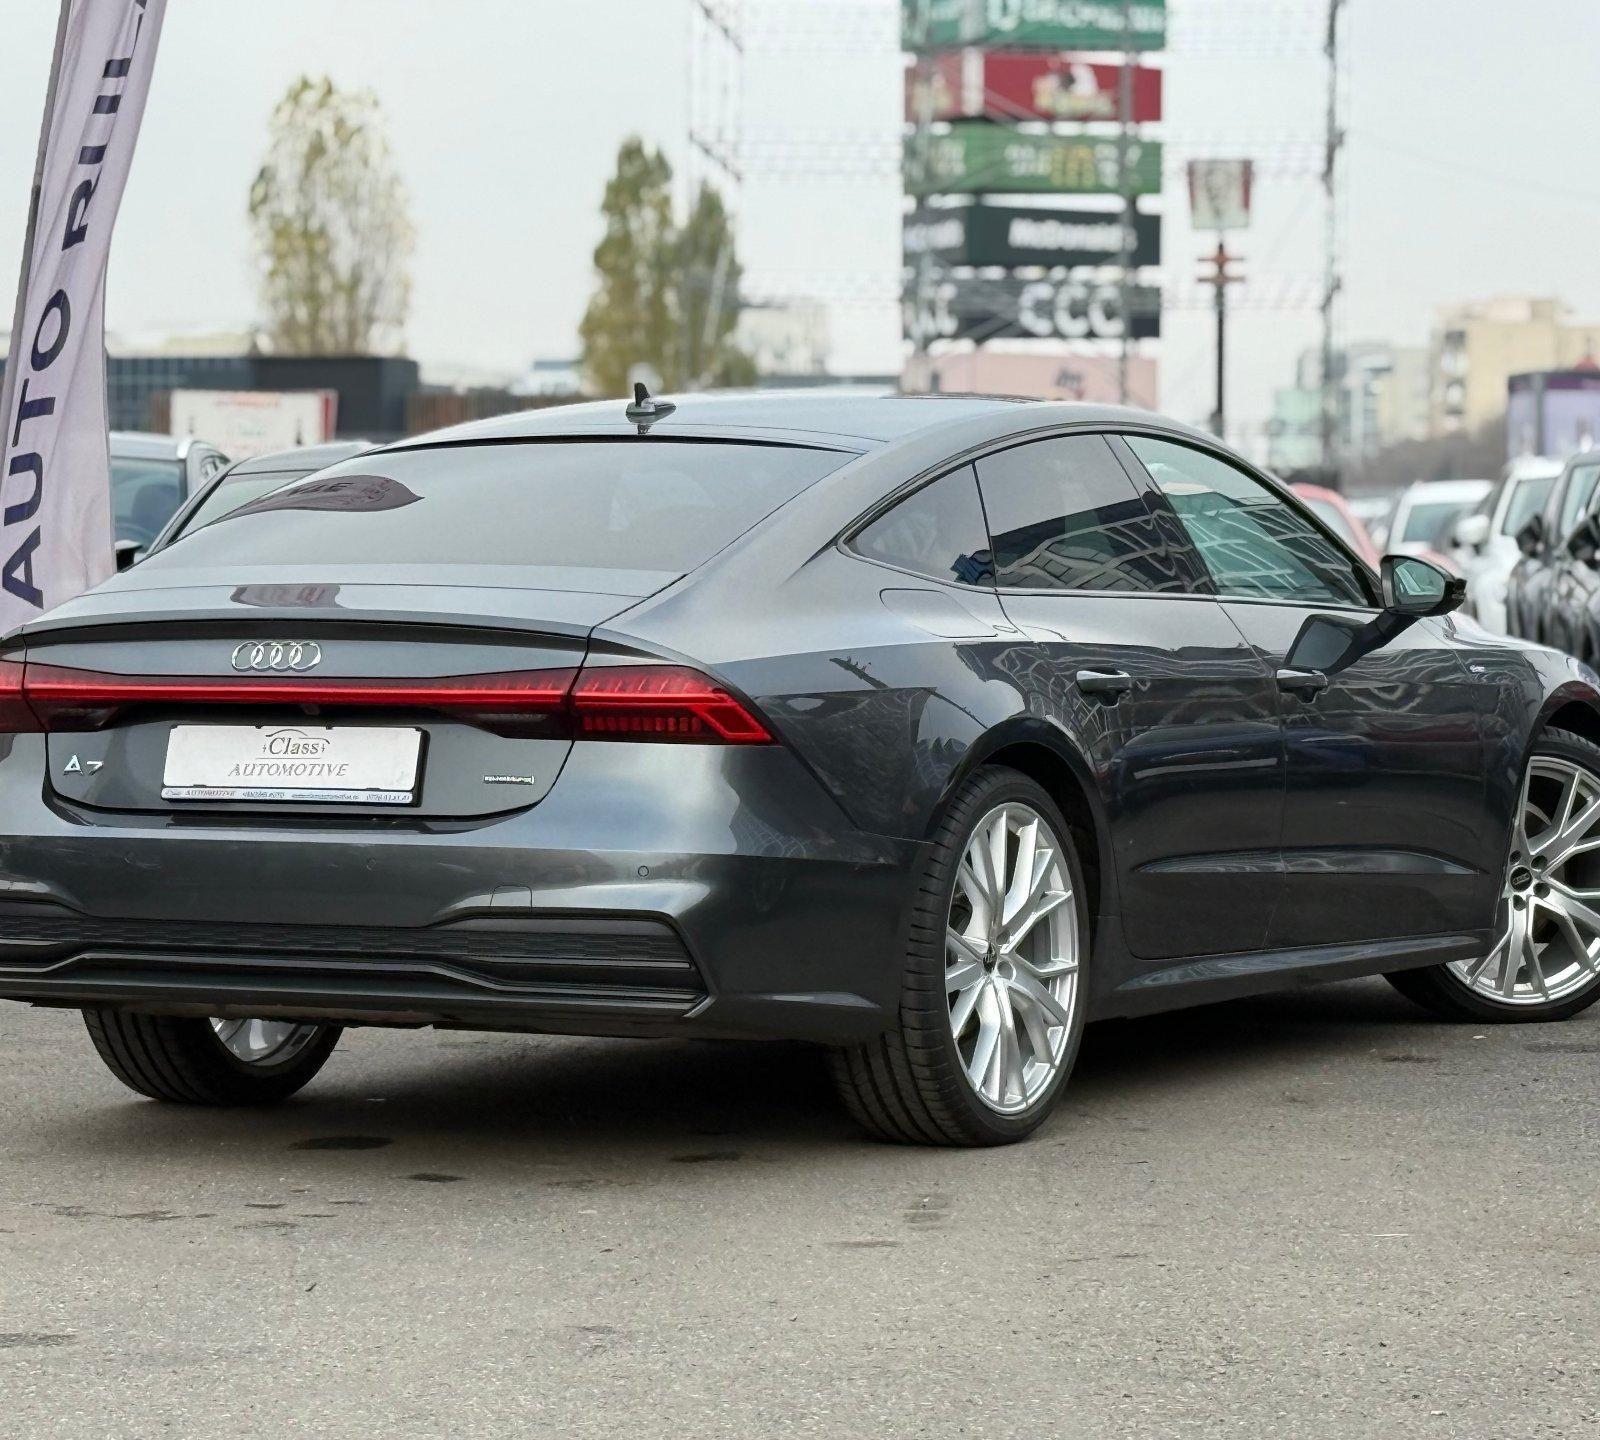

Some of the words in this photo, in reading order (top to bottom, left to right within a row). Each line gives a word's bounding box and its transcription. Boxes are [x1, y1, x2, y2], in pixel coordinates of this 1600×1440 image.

[2, 288, 71, 609] AUTO
[268, 737, 320, 755] Class
[63, 754, 104, 775] A7
[228, 763, 350, 777] AUTOMOTIVE
